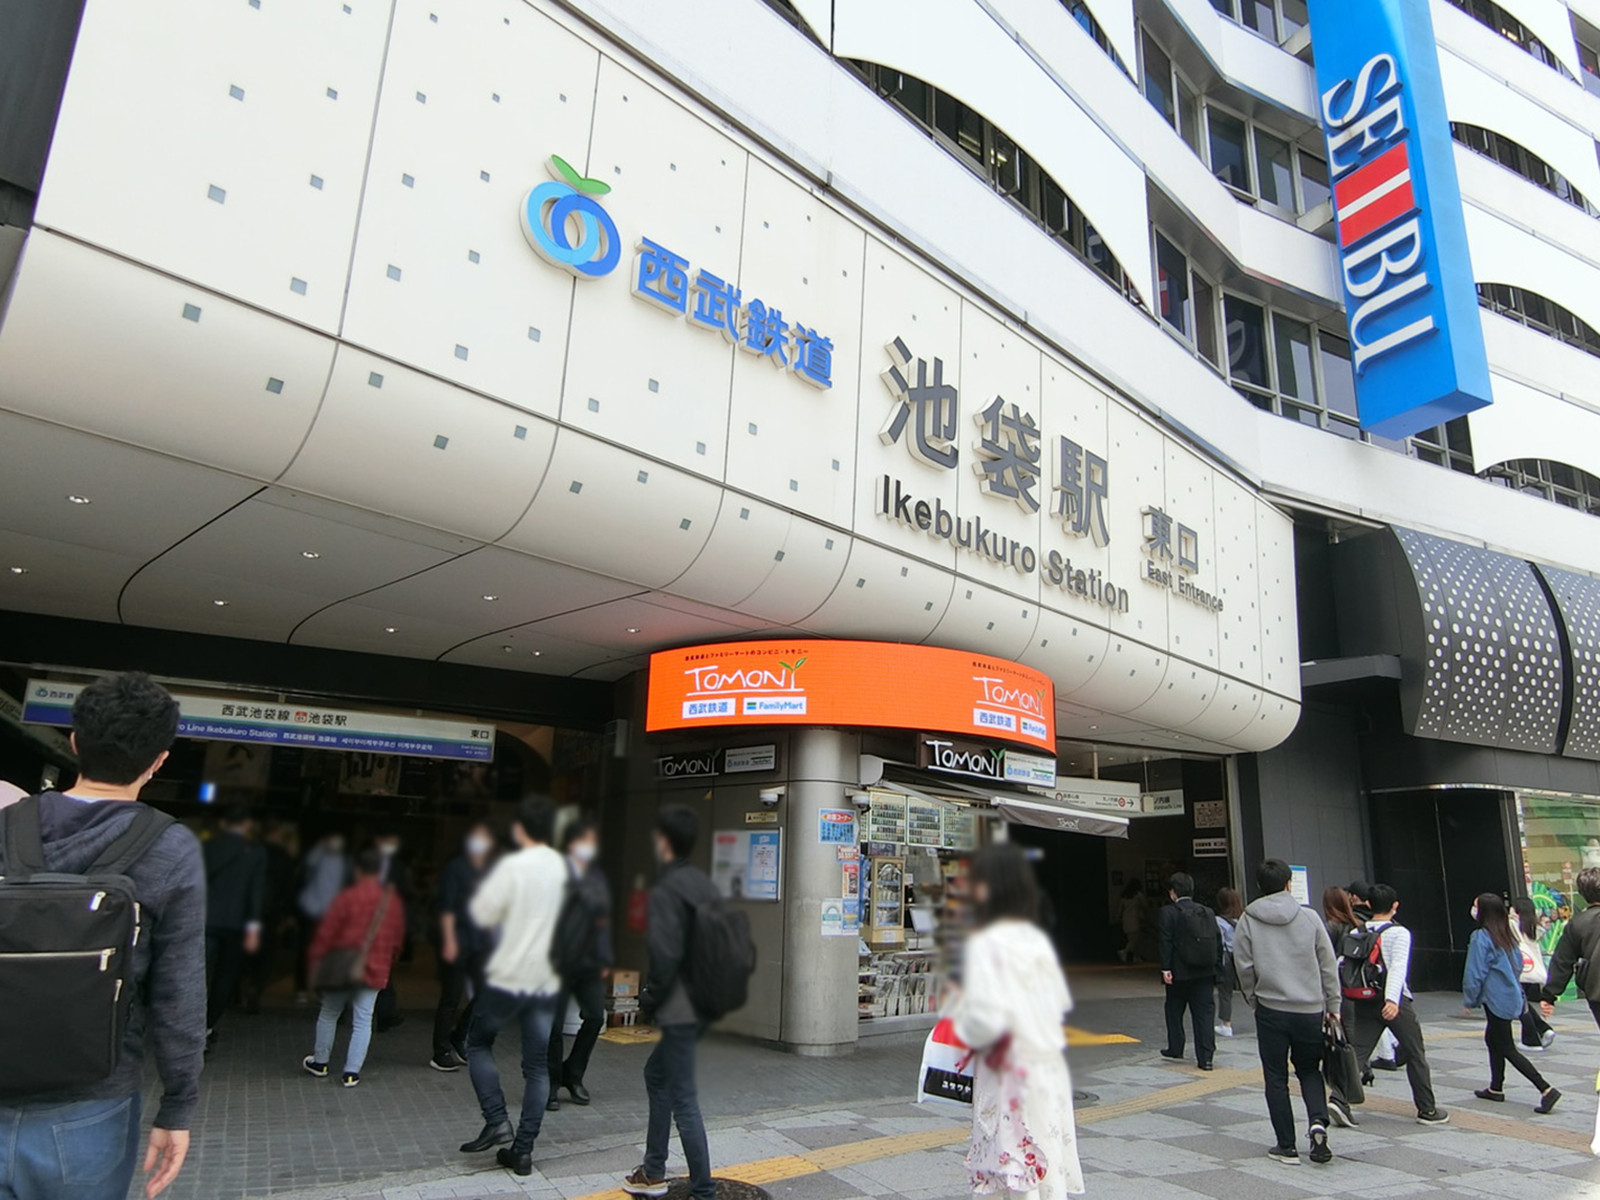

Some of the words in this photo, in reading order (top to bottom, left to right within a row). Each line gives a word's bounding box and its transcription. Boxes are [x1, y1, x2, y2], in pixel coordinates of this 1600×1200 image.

[1322, 53, 1435, 374] SEIBU
[632, 236, 834, 389] 西武鉄道
[880, 336, 1110, 547] 池袋駅
[878, 475, 1036, 575] Ikebukuro
[1042, 549, 1129, 613] Station
[1142, 505, 1199, 574] 東口
[1142, 561, 1173, 589] East
[1174, 575, 1224, 613] Entrance
[187, 724, 206, 733] Line
[206, 726, 248, 736] Ikebukuro
[249, 729, 278, 739] Station
[222, 704, 290, 721] 西武池袋線
[308, 712, 348, 726] 池袋駅
[688, 702, 728, 715] 西武鉄道
[759, 702, 803, 711] FamilyMart
[470, 729, 490, 740] 東口
